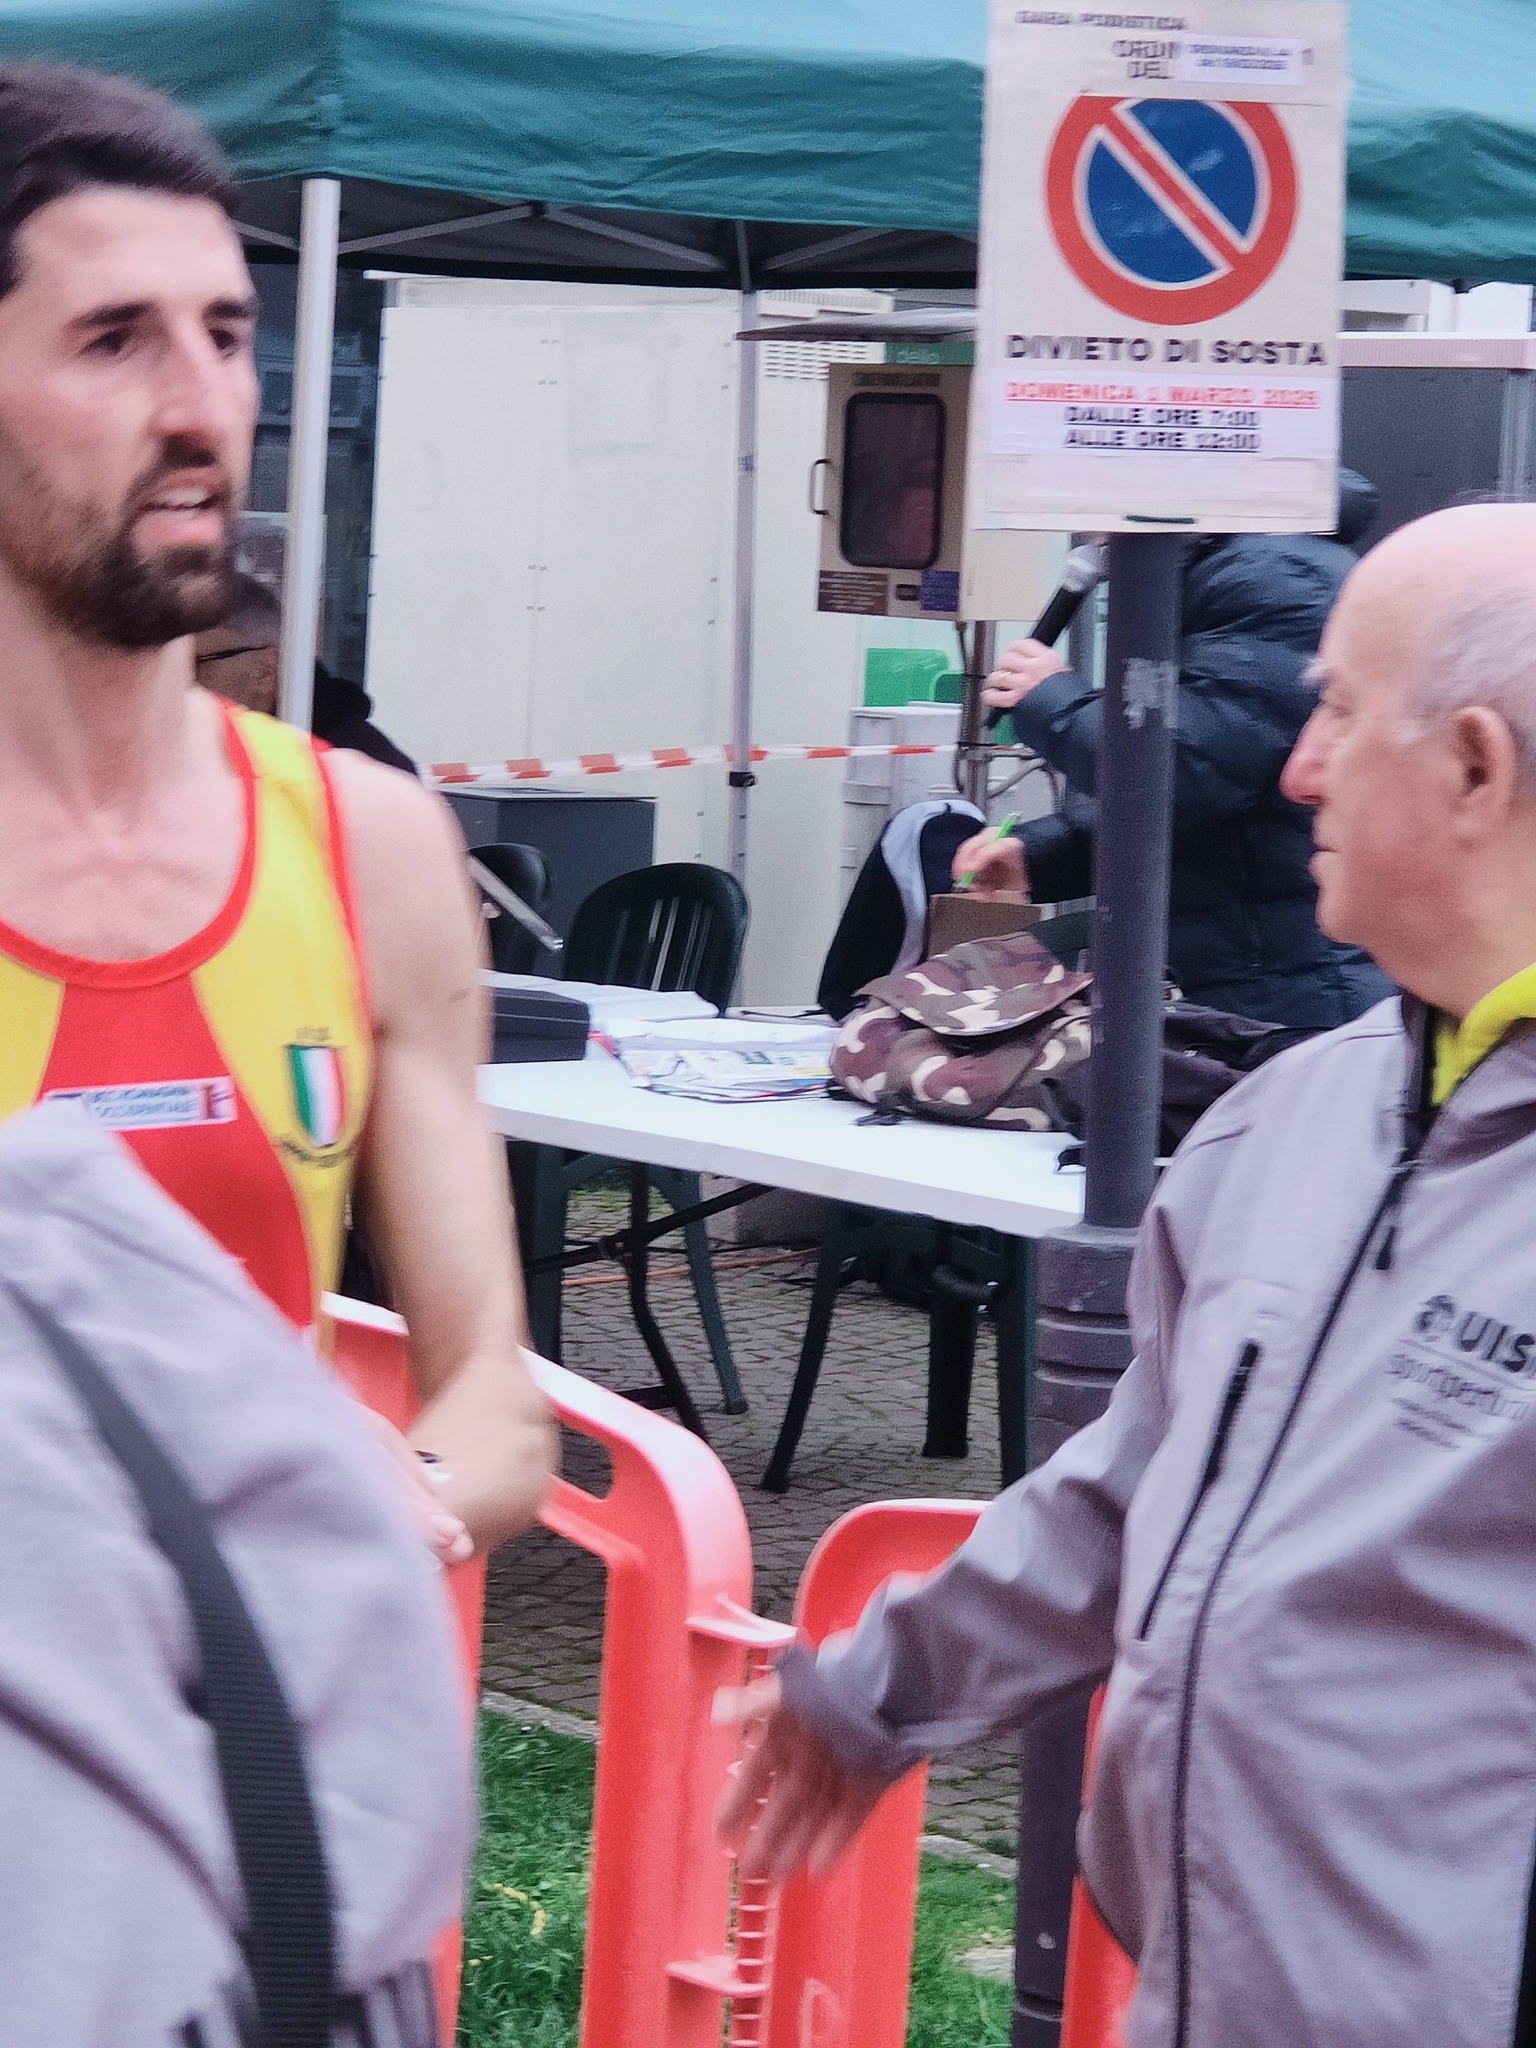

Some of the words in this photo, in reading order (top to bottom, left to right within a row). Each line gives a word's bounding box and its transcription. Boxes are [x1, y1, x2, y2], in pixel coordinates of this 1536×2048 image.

[1005, 335, 1153, 360] DIVIETO
[1162, 338, 1201, 362] DI
[1209, 339, 1327, 365] SOSTA
[1004, 382, 1136, 399] DOMENICA
[1146, 386, 1160, 401] 1
[1168, 387, 1254, 404] MARZO
[1064, 406, 1145, 423] DALLE
[1150, 408, 1203, 425] ORE
[1210, 410, 1262, 427] 7:00
[1064, 429, 1130, 445] ALLE
[1133, 431, 1186, 448] ORE
[1196, 433, 1262, 449] 12:00
[1455, 1310, 1536, 1377] UIS
